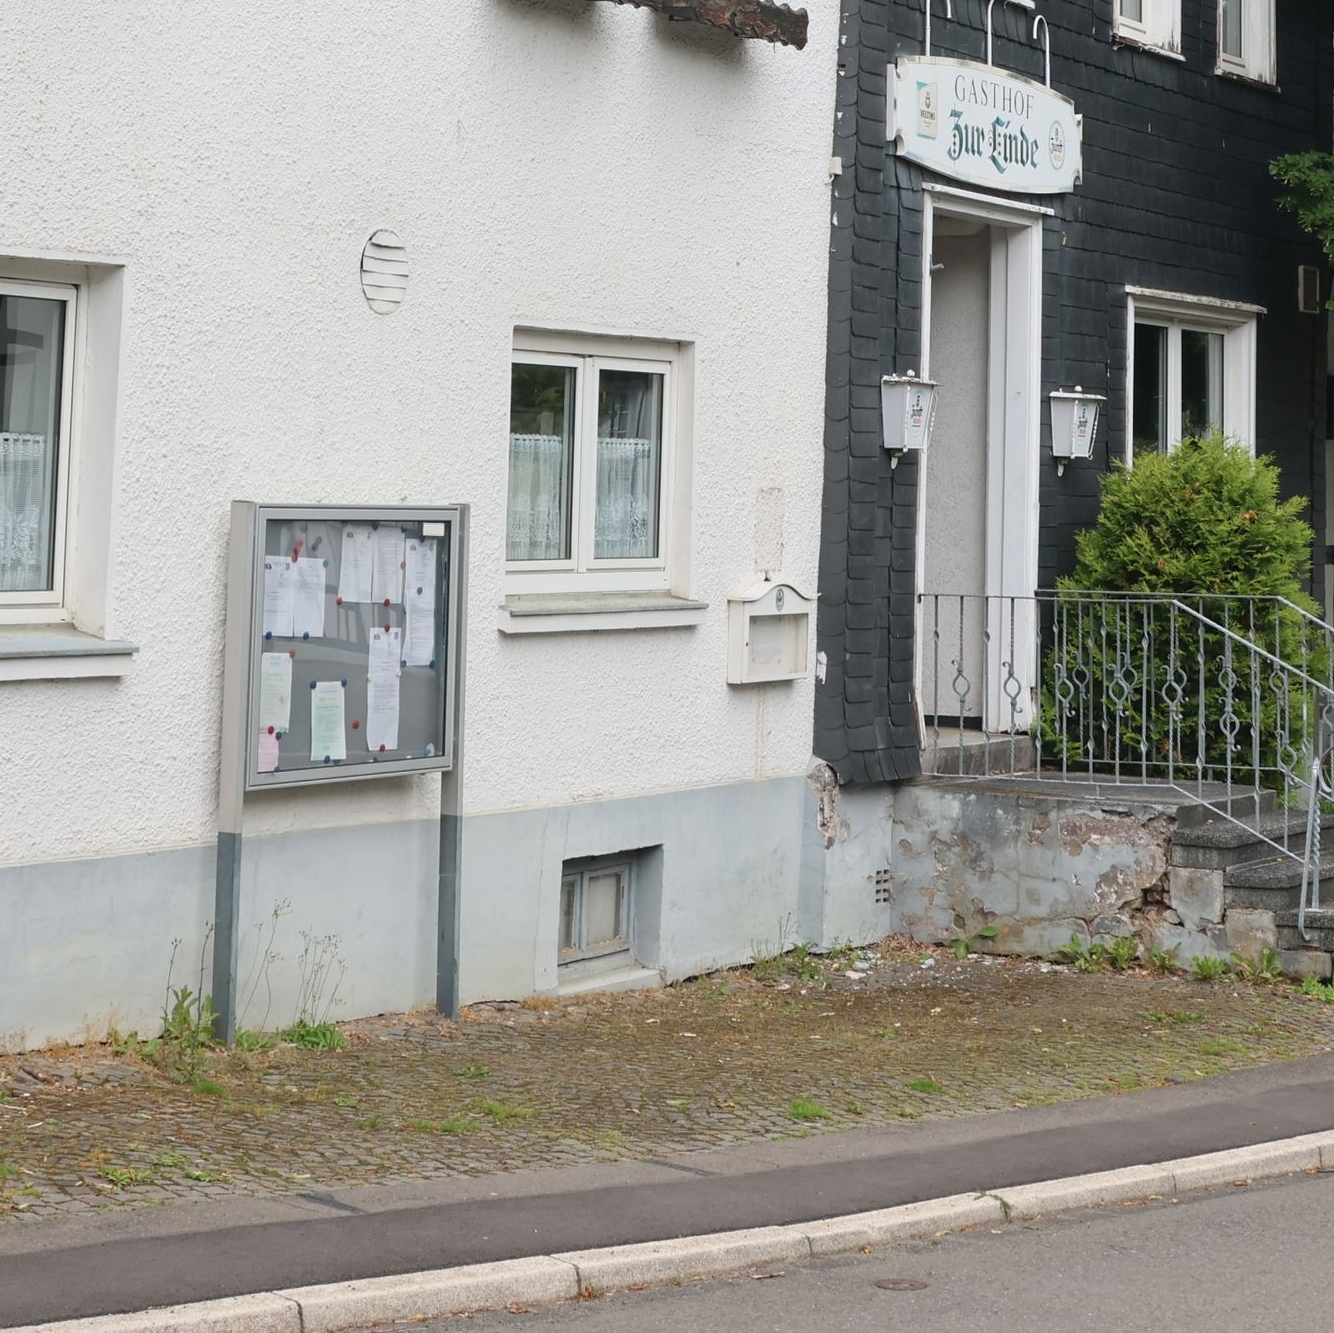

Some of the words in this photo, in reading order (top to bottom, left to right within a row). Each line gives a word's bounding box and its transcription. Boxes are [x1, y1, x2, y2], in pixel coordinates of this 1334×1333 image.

[954, 74, 1034, 119] GASTHOF
[947, 109, 985, 161] Zur
[988, 116, 1039, 174] Linde
